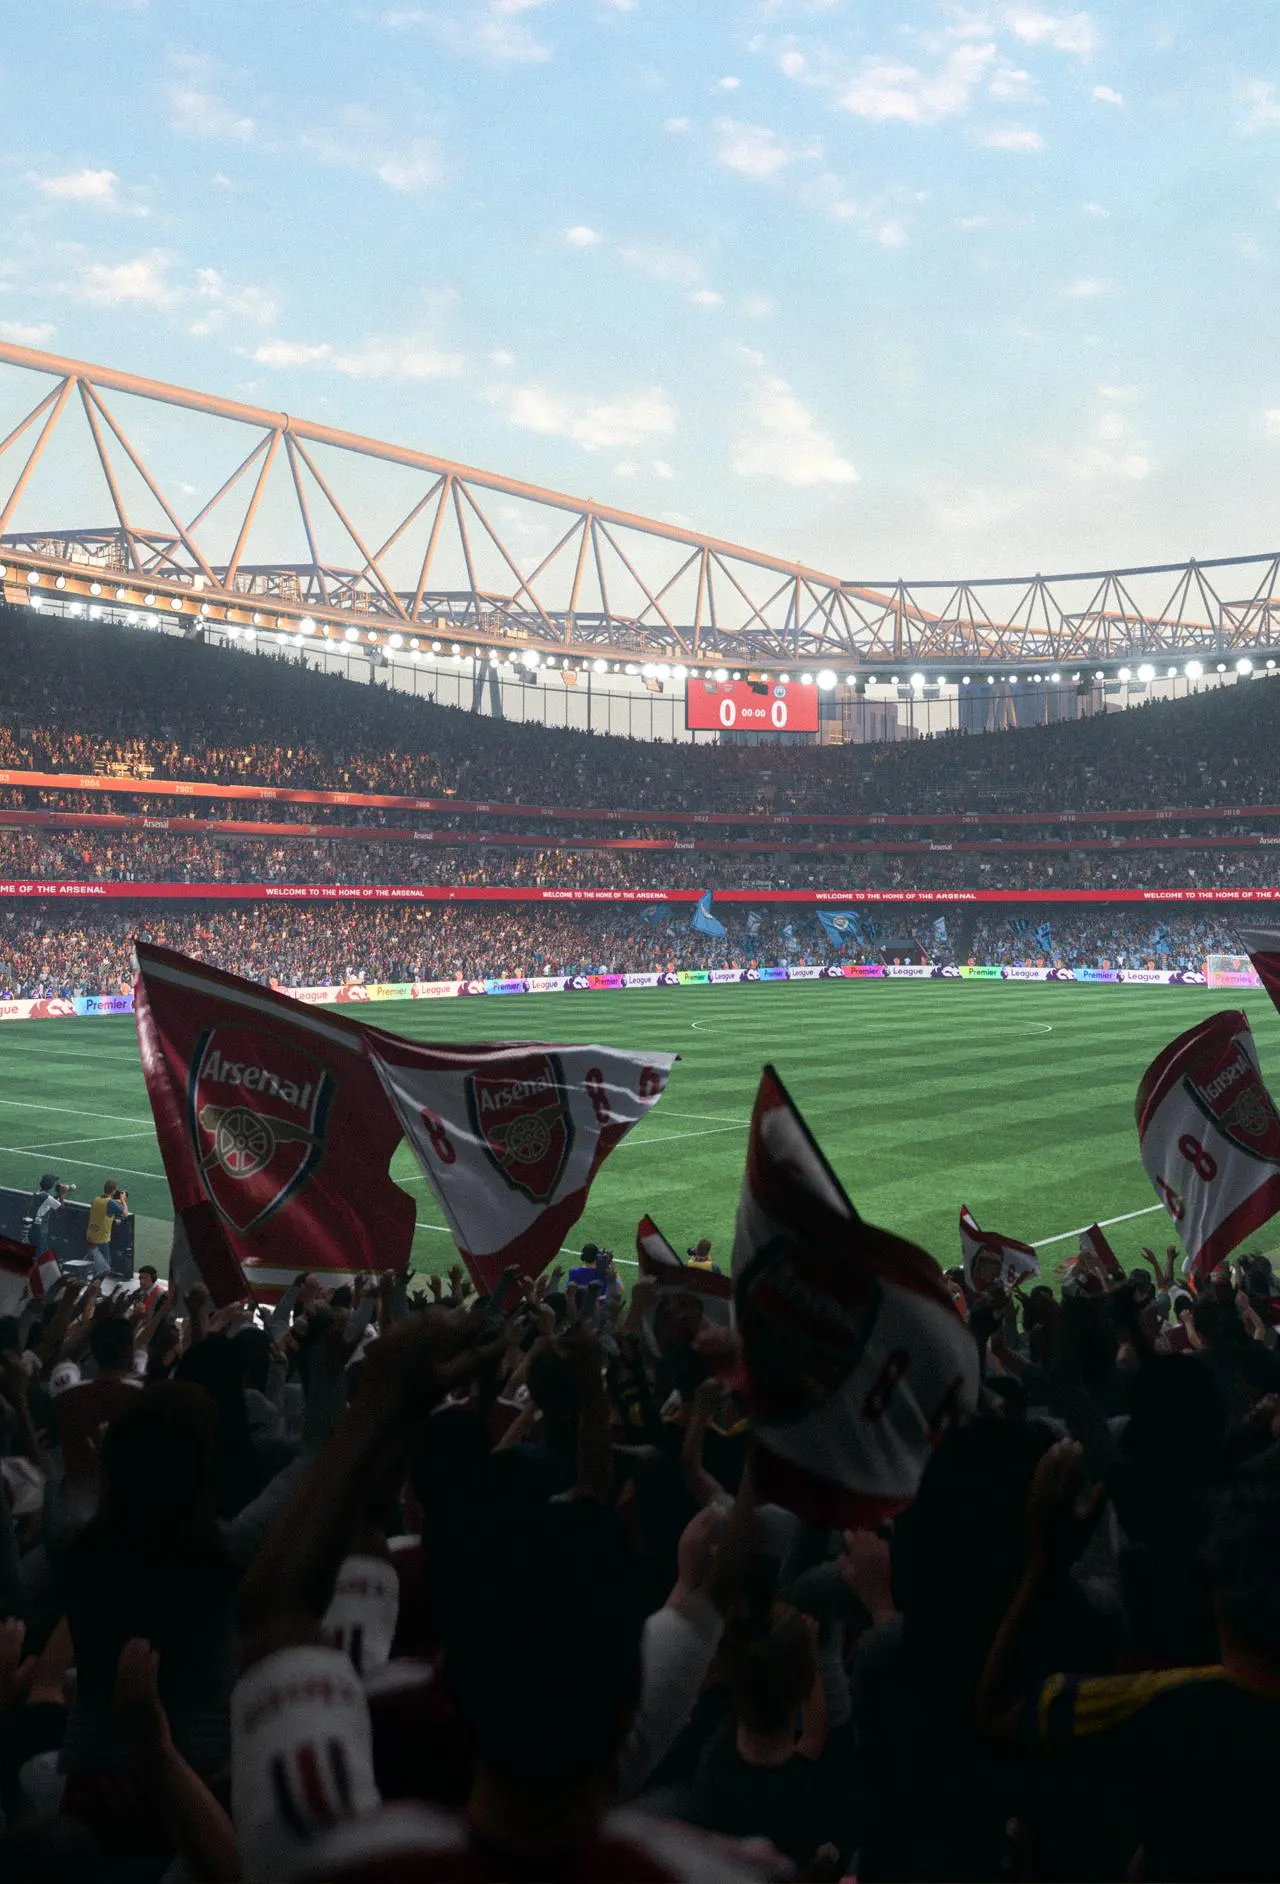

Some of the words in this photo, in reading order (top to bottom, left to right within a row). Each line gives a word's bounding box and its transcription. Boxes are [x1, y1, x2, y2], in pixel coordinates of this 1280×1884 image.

[720, 698, 736, 727] 0
[741, 708, 766, 717] 00:00
[771, 700, 788, 728] 0
[80, 779, 100, 788] 2004
[175, 785, 194, 794] 2005
[143, 819, 169, 829] Arsenal
[19, 885, 33, 894] OF
[37, 885, 56, 894] THE
[59, 886, 106, 894] ARSENAL
[265, 888, 307, 896] WELCOME
[684, 973, 706, 981] Premier
[715, 972, 735, 980] League
[764, 969, 783, 977] Premier
[792, 969, 814, 977] League
[850, 967, 879, 975] Premier
[893, 968, 924, 976] League
[968, 968, 997, 976] Premier
[1011, 969, 1039, 977] League
[1083, 971, 1113, 979] Premier
[1127, 971, 1161, 981] League
[493, 981, 520, 990] Premier
[532, 980, 559, 990] League
[594, 977, 618, 985] Premier
[629, 976, 652, 985] League
[377, 986, 407, 996] Premier
[421, 984, 451, 995] League
[294, 990, 328, 1001] League
[86, 999, 127, 1010] Premier
[201, 1049, 314, 1111] Arsenal
[480, 1067, 551, 1113] Arsenal
[421, 1108, 456, 1164] 8
